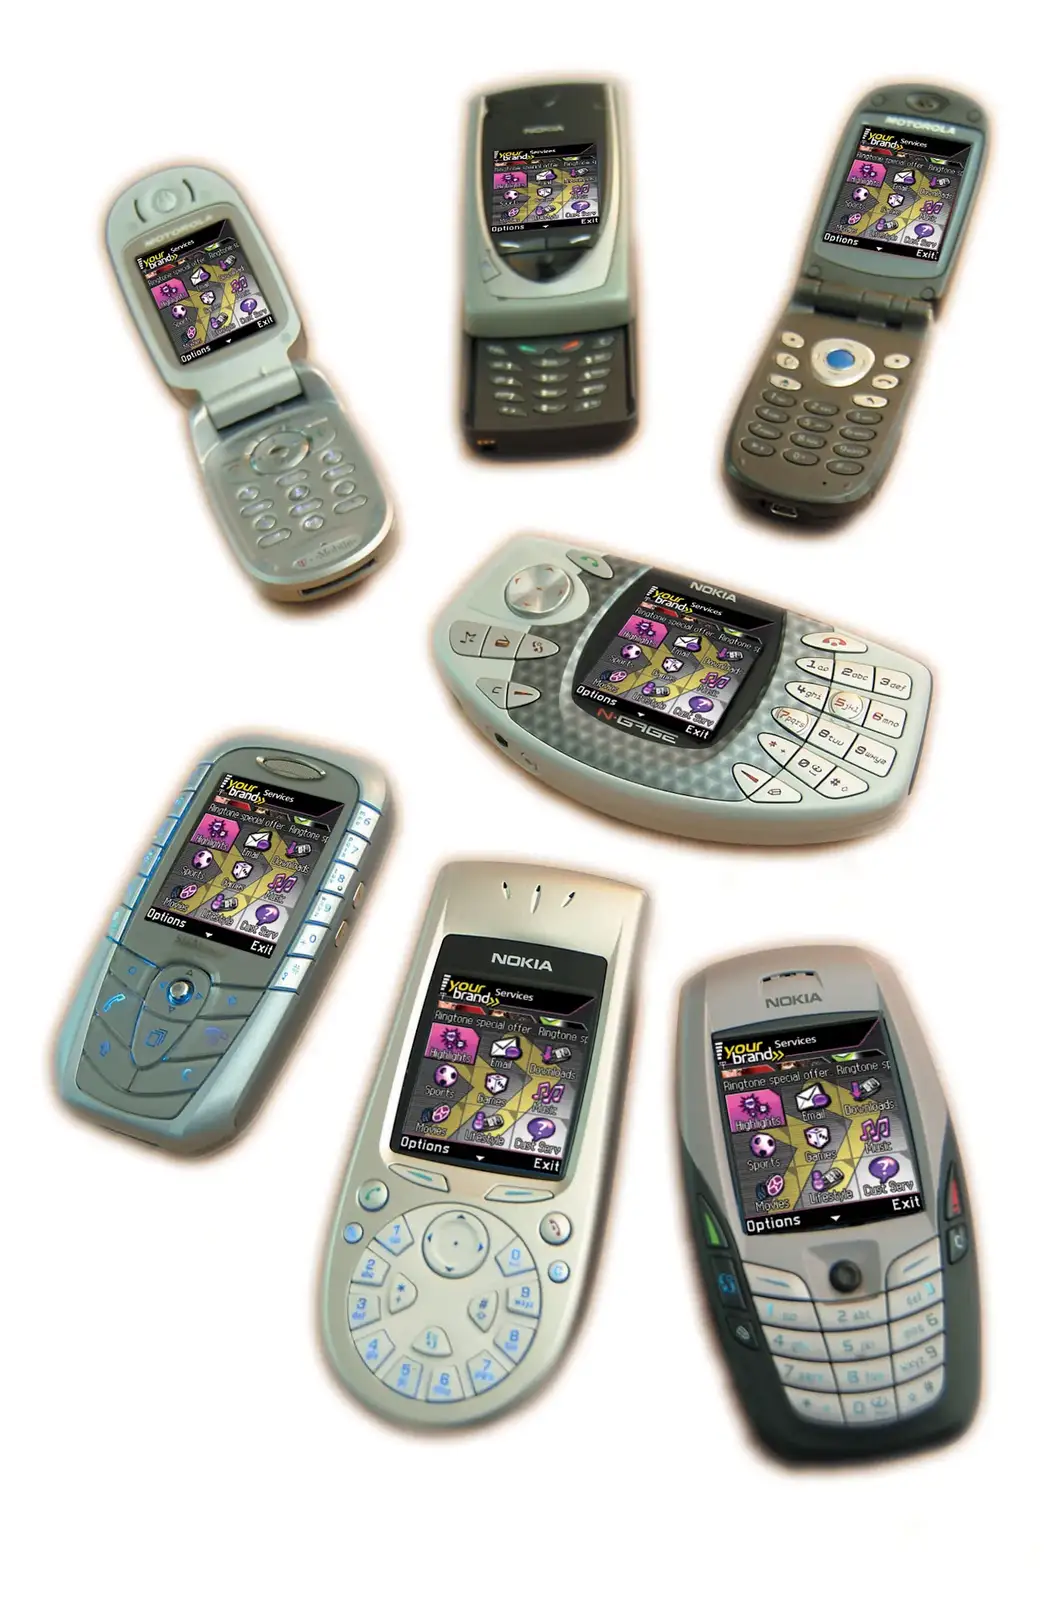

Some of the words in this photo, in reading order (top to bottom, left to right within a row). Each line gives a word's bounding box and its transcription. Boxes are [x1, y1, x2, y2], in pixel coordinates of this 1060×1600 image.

[884, 116, 956, 135] MOTOROLA
[868, 131, 895, 142] your
[871, 138, 897, 149] brand
[900, 138, 928, 148] Services
[856, 152, 884, 163] Ringtone
[142, 251, 165, 267] your
[170, 239, 195, 253] Services
[824, 232, 859, 246] Options
[916, 249, 936, 260] Exit
[149, 253, 171, 270] brand
[180, 345, 211, 363] Options
[257, 316, 274, 329] Exit
[652, 589, 684, 603] your
[690, 582, 738, 603] NOKIA
[655, 596, 686, 612] brand
[690, 601, 723, 616] Services
[635, 607, 667, 623] Ringtone
[668, 616, 692, 631] special
[718, 633, 750, 649] Ringtone
[576, 685, 618, 706] Options
[685, 725, 710, 739] Exit
[227, 779, 258, 793] your
[228, 787, 259, 802] brand
[263, 789, 295, 803] Services
[208, 803, 240, 819] Ringtone
[240, 811, 264, 826] special
[289, 824, 321, 840] Ringtone
[196, 834, 229, 850] Highlights
[241, 848, 260, 859] Email
[180, 865, 206, 880] Sports
[147, 908, 187, 928] Options
[250, 940, 274, 955] Exit
[240, 918, 260, 933] Cust
[258, 926, 279, 939] Serv
[491, 952, 553, 972] NOKIA
[449, 979, 486, 993] your
[453, 988, 491, 1004] brand
[495, 988, 534, 1002] Services
[765, 992, 823, 1008] NOKIA
[435, 1010, 473, 1025] Ringtone
[476, 1018, 505, 1030] special
[538, 1027, 577, 1043] Ringtone
[724, 1040, 763, 1058] your
[774, 1035, 817, 1049] Services
[430, 1048, 471, 1063] Highlights
[732, 1050, 773, 1064] brand
[490, 1058, 512, 1069] Email
[529, 1064, 576, 1080] Downloads
[723, 1076, 766, 1092] Ringtone
[769, 1073, 801, 1085] special
[836, 1061, 879, 1077] Ringtone
[425, 1085, 455, 1099] Sports
[477, 1094, 507, 1106] Games
[532, 1102, 558, 1116] Music
[802, 1110, 825, 1122] Email
[844, 1100, 895, 1116] Downloads
[416, 1123, 447, 1136] Movies
[735, 1116, 781, 1131] Highlights
[464, 1130, 505, 1147] Lifestyle
[514, 1138, 537, 1151] Cust
[538, 1143, 562, 1155] Serv
[400, 1136, 450, 1154] Options
[534, 1158, 560, 1172] Exit
[805, 1150, 837, 1163] Games
[865, 1141, 892, 1154] Music
[747, 1158, 781, 1172] Sports
[809, 1187, 853, 1204] Lifestyle
[863, 1184, 888, 1197] Cust
[889, 1179, 914, 1193] Serv
[755, 1198, 790, 1212] Movies
[747, 1215, 801, 1232] Options
[892, 1197, 920, 1211] Exit
